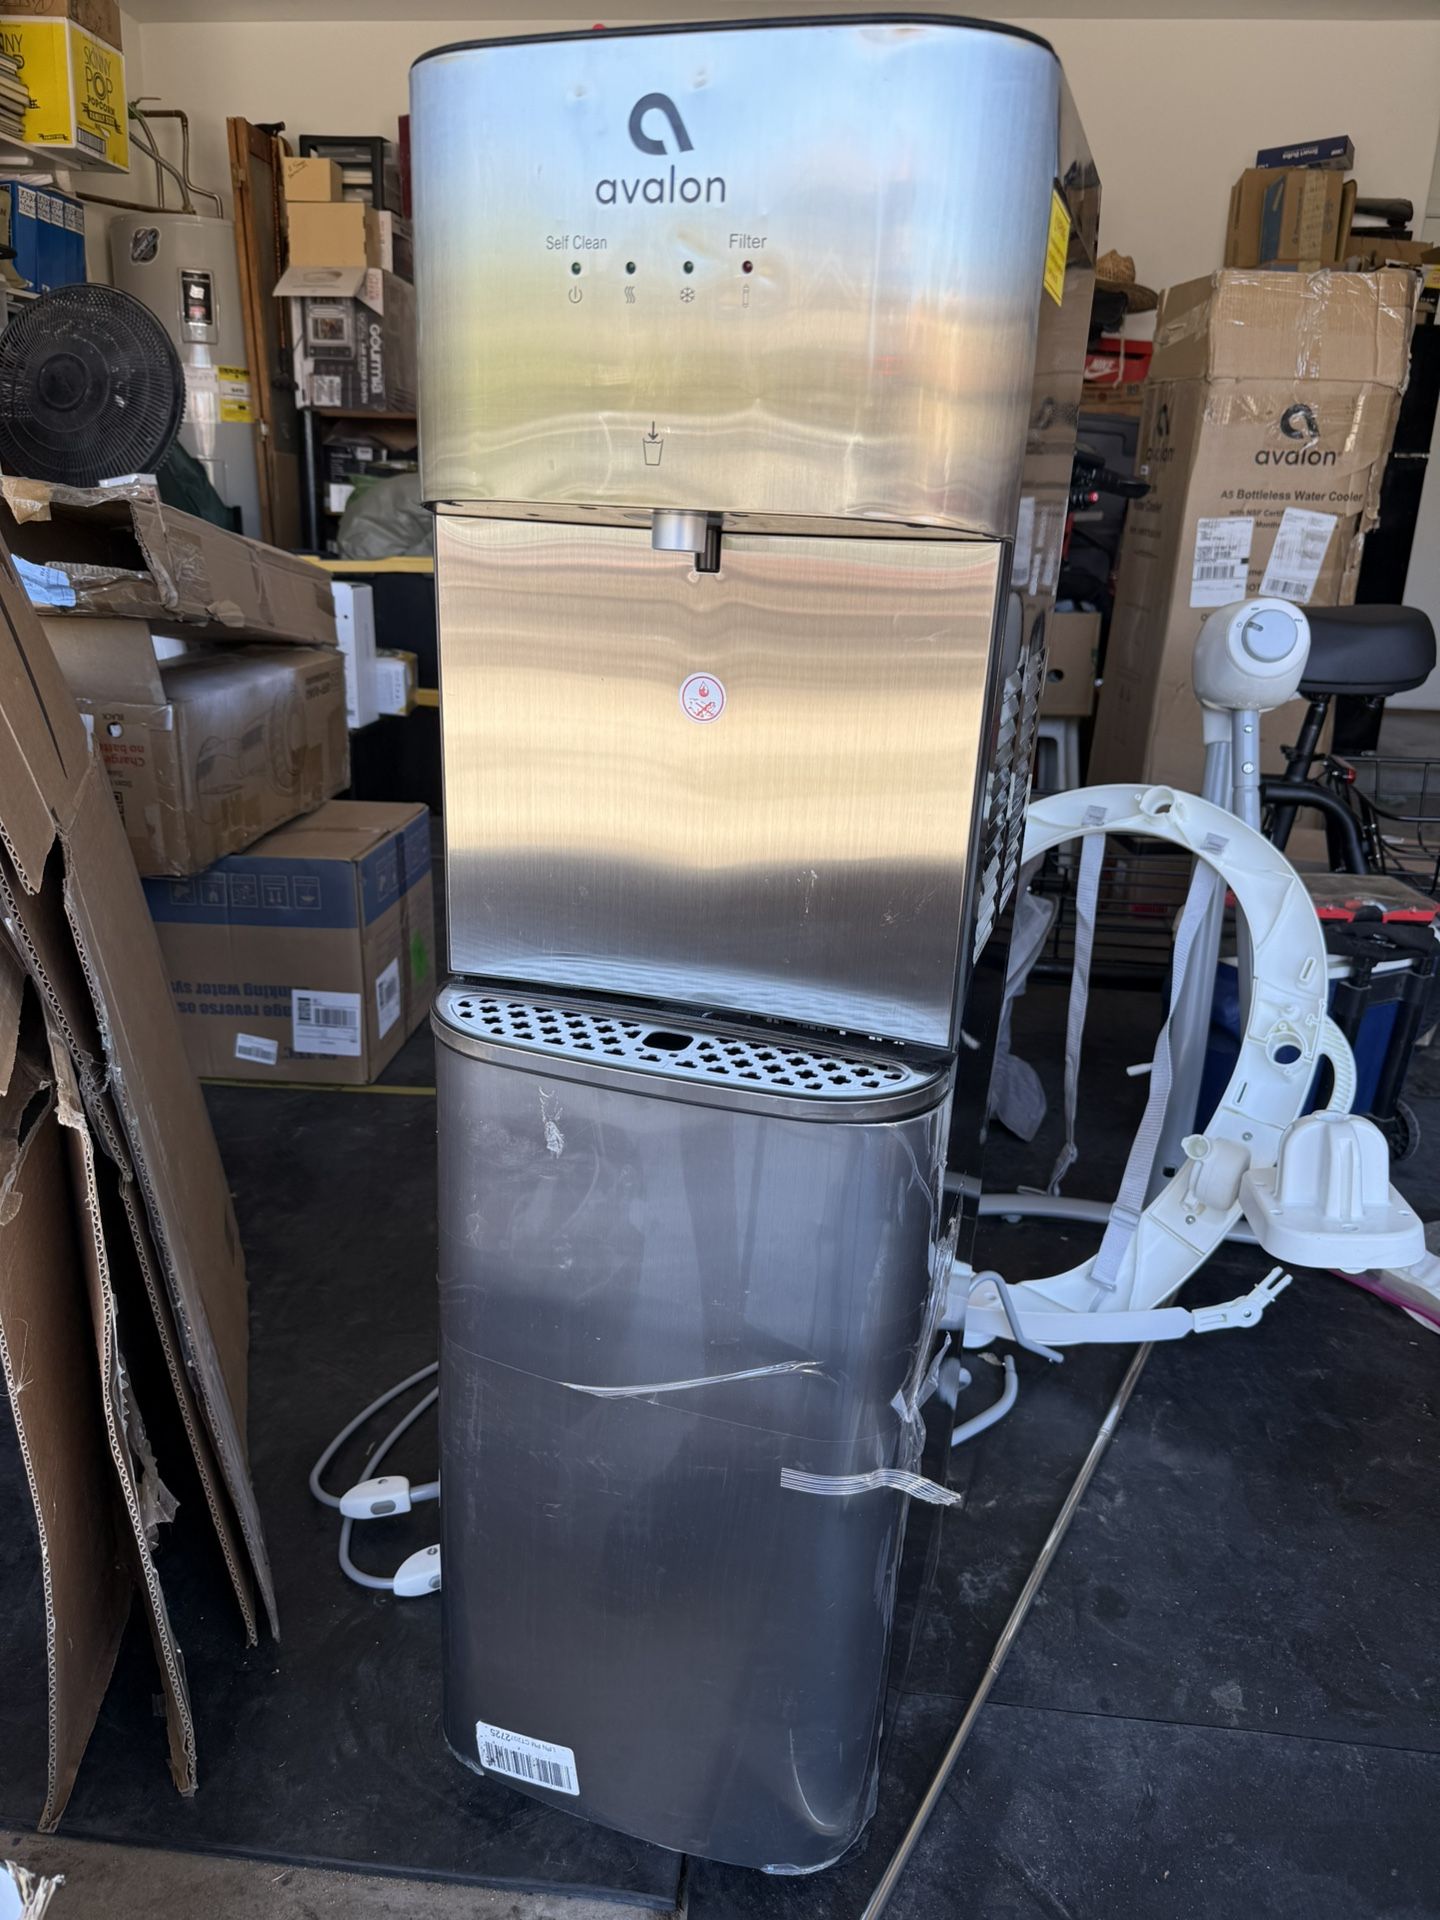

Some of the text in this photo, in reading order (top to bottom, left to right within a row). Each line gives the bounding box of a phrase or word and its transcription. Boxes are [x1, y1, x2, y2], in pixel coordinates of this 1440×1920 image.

[85, 66, 114, 104] POP
[595, 164, 726, 205] avalon
[546, 235, 607, 250] Self Clean
[729, 233, 767, 249] Filter
[1255, 449, 1336, 466] avalon
[1221, 489, 1363, 501] A5 Bottleless Water Cooler
[196, 983, 241, 997] water
[199, 1003, 260, 1017] reverse
